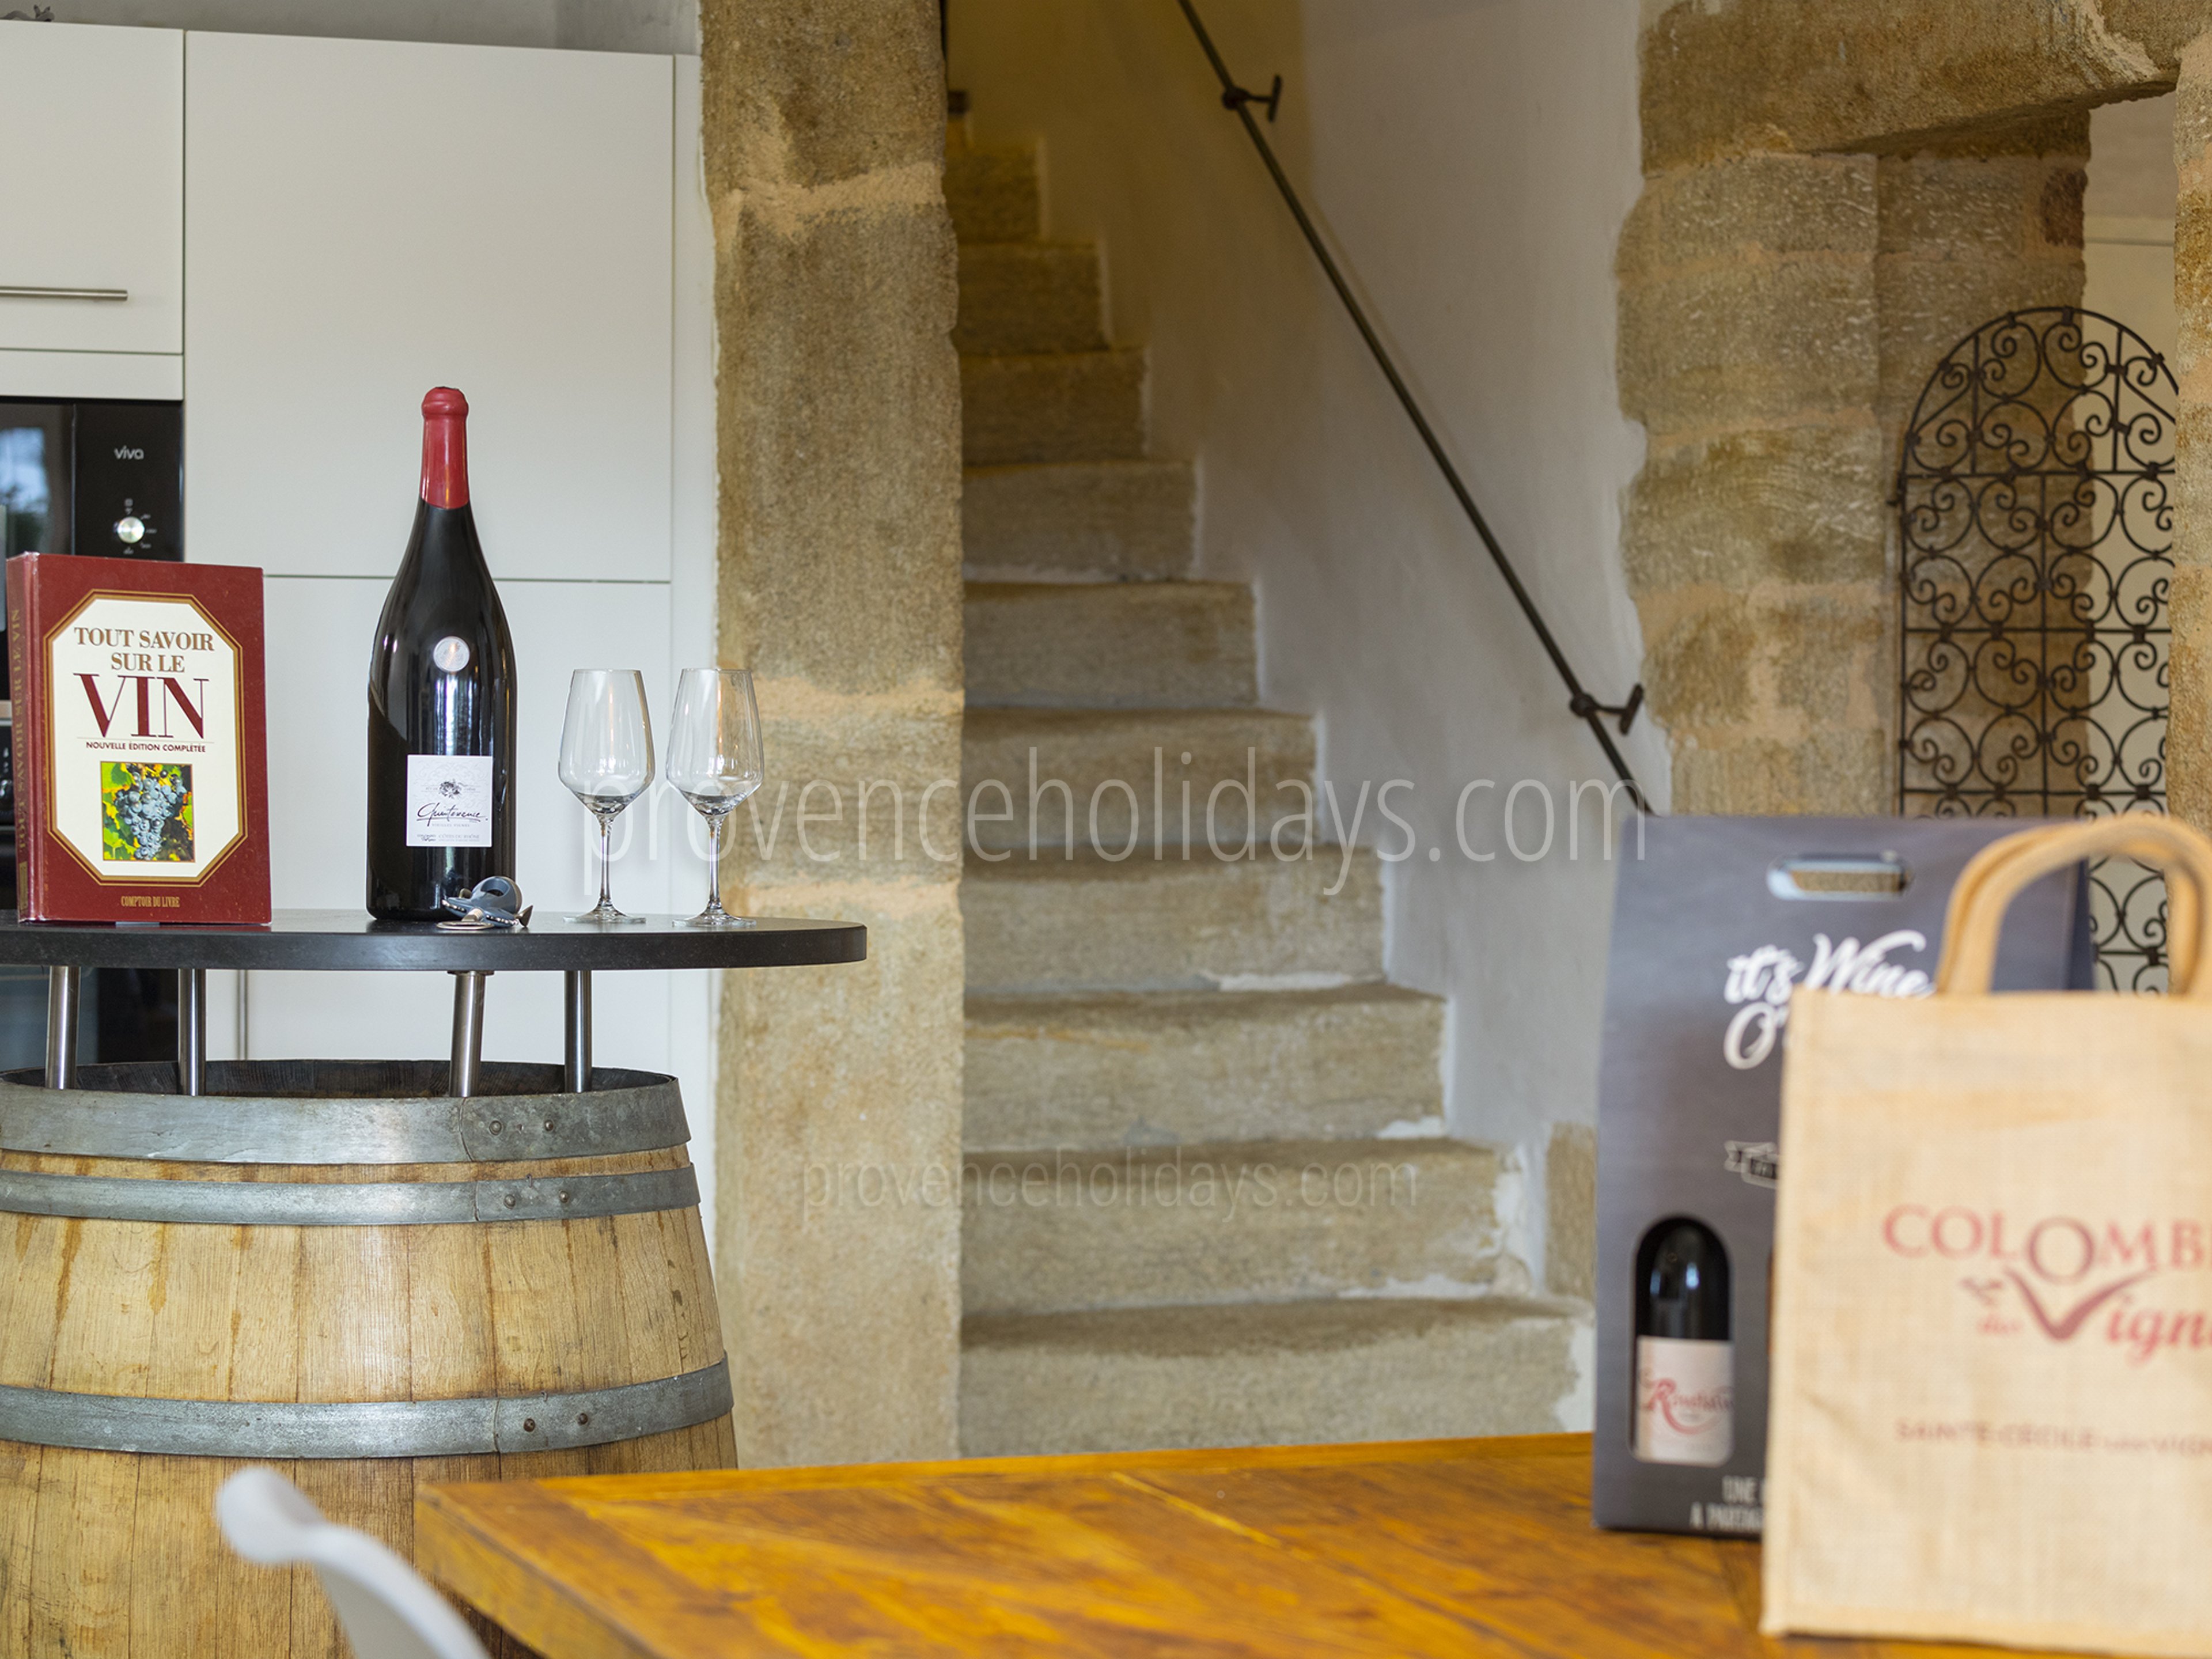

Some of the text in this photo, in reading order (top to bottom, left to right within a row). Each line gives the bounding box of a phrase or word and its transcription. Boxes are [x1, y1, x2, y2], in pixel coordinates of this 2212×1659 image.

[114, 445, 144, 459] viva
[74, 627, 215, 651] TOUT SAVOIR
[111, 652, 185, 673] SUR LE
[73, 673, 210, 739] VIN
[86, 741, 126, 749] NOUVELLE
[121, 896, 180, 907] COMPTOIR DU LIVRE
[1805, 930, 1937, 999] Wine
[1881, 1203, 2212, 1286] COLOMB
[2002, 1266, 2212, 1368] Vign
